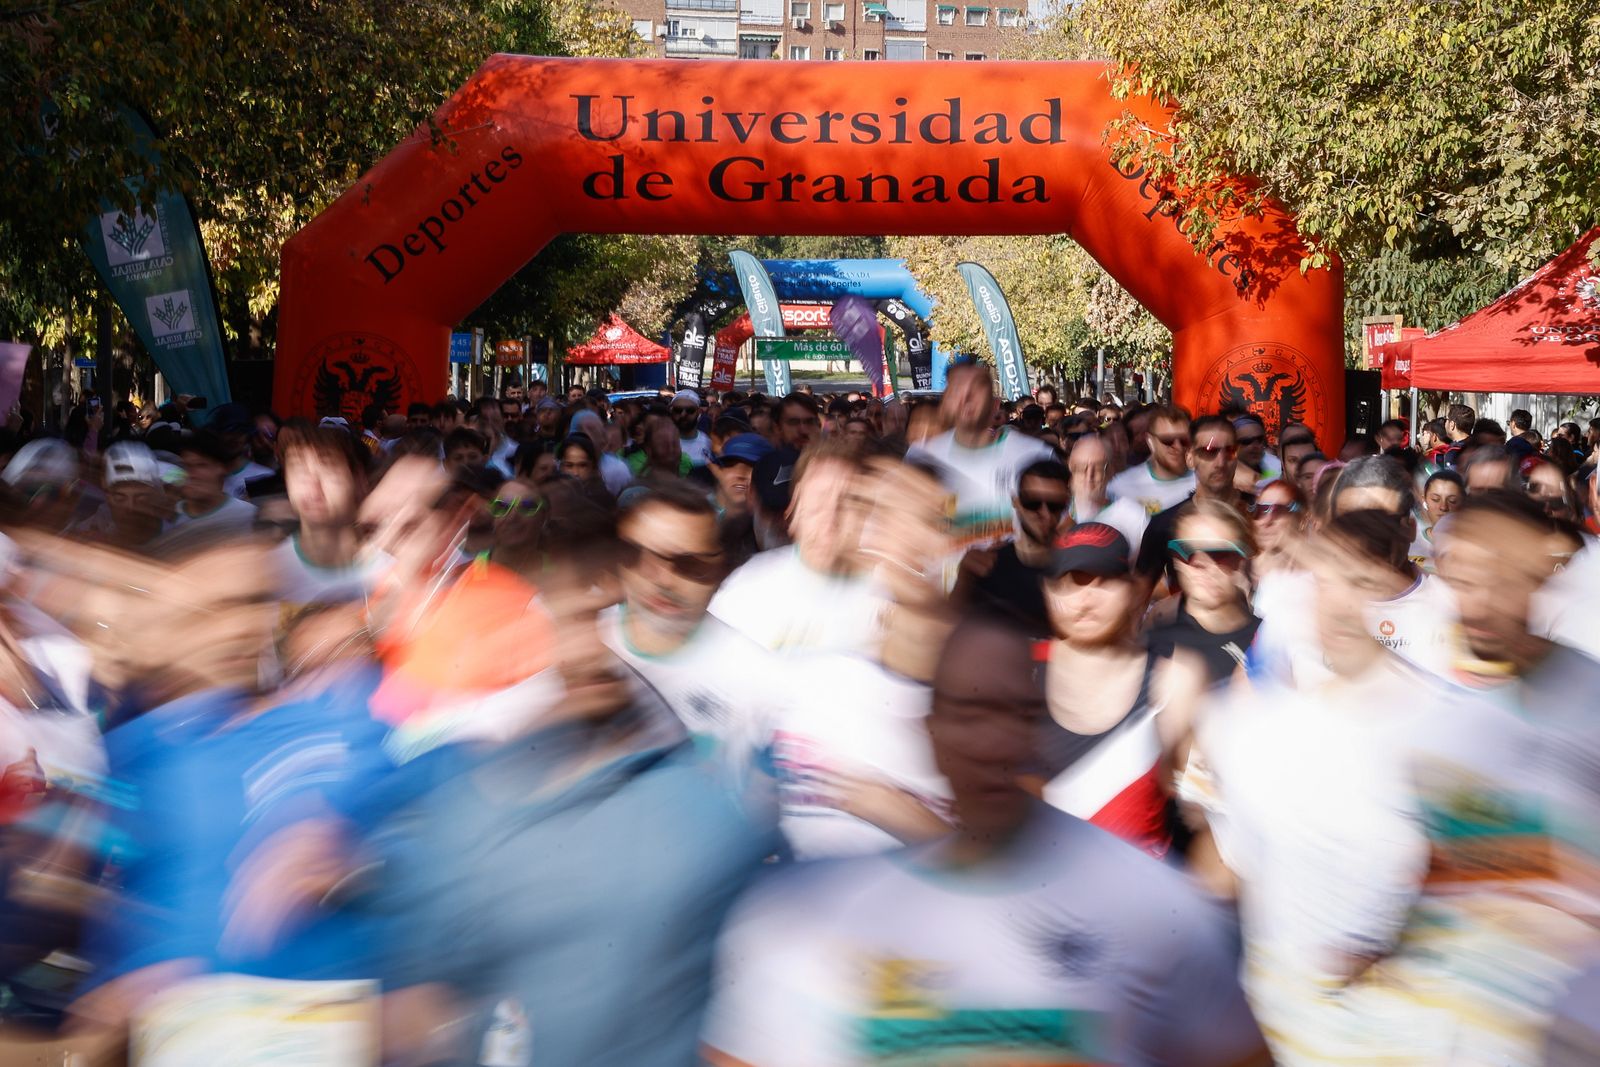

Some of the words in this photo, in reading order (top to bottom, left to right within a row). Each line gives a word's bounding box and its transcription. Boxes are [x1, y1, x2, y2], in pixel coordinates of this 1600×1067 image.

[569, 94, 1067, 144] Universidad
[583, 154, 674, 201] de
[708, 156, 1051, 203] Granada
[365, 146, 522, 284] Deportes
[826, 280, 862, 289] Deportes
[793, 342, 814, 352] Más
[816, 342, 829, 352] de
[830, 342, 843, 352] 60
[679, 372, 700, 383] TRAIL
